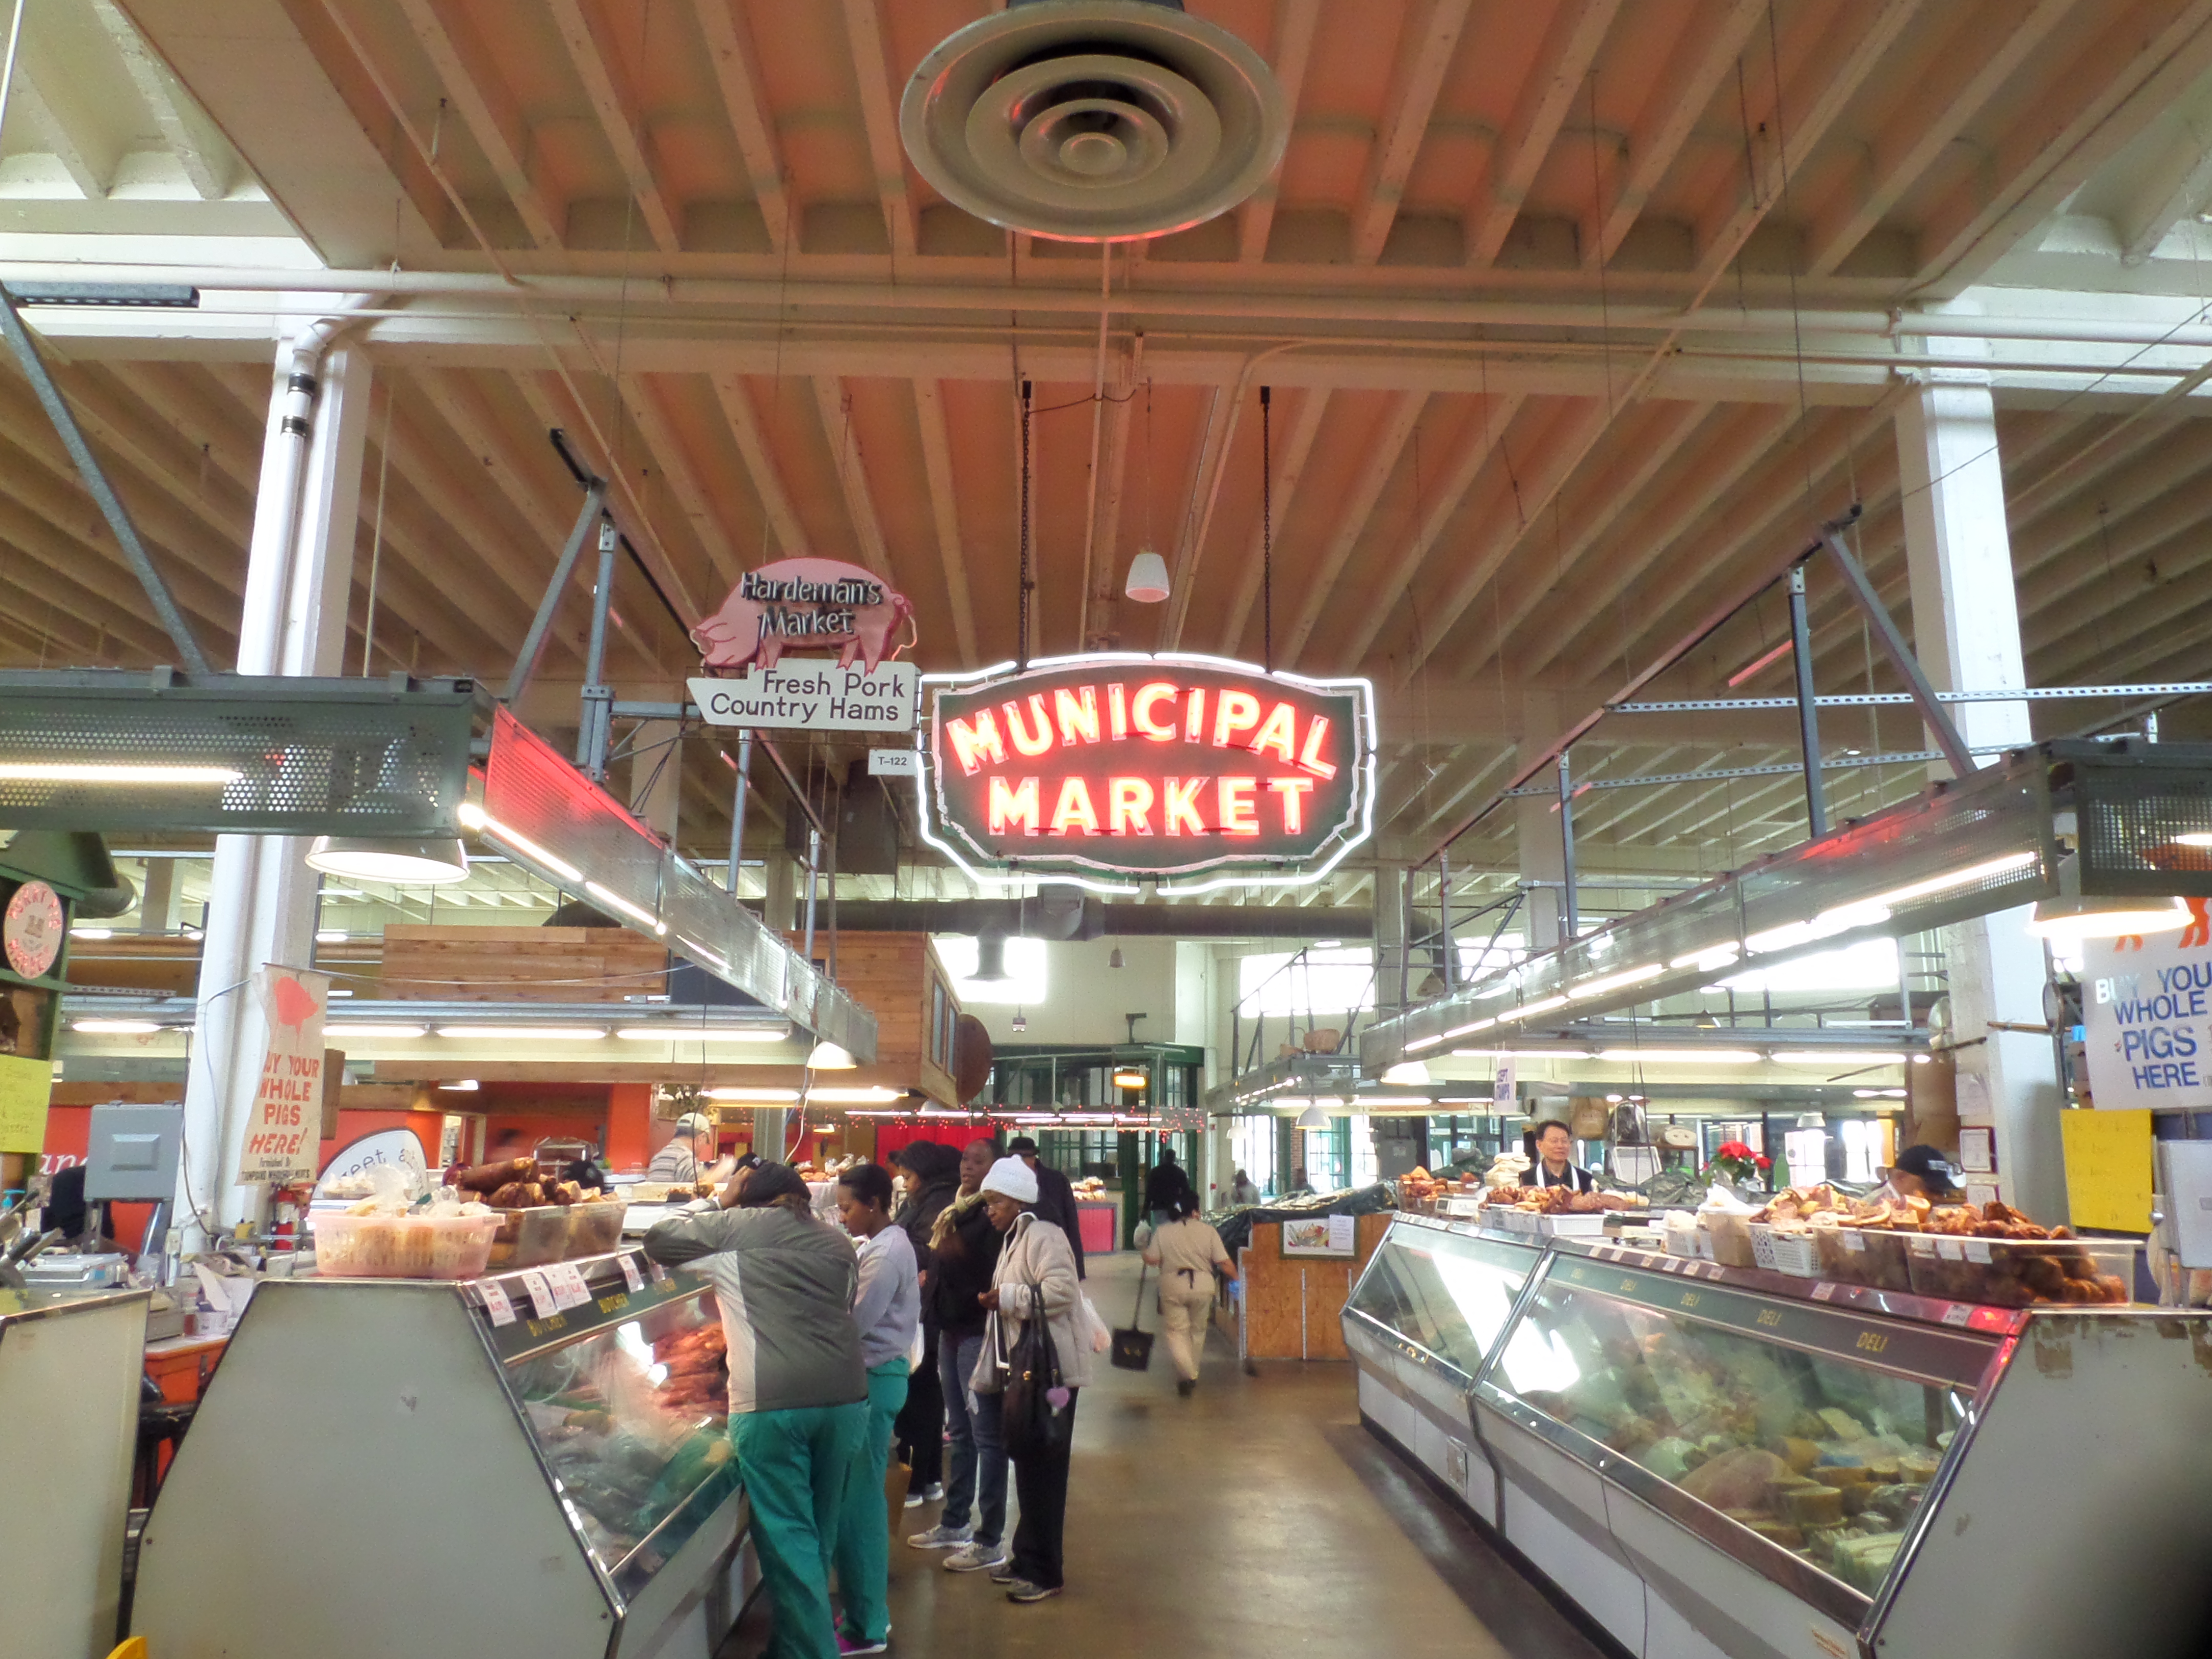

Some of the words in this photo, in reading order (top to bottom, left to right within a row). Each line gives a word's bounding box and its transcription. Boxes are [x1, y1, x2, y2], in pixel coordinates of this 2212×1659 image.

[740, 571, 884, 605] Hardeman's
[758, 606, 856, 639] Market
[763, 670, 831, 696] Fresh
[844, 672, 905, 698] Pork
[711, 693, 818, 724] Country
[830, 697, 899, 720] Hams
[945, 682, 1336, 780] MUNICIPAL
[878, 756, 907, 765] T-122
[988, 776, 1314, 837] MARKET
[2114, 990, 2208, 1025] WHOLE
[2123, 1026, 2197, 1061] PIGS
[289, 1055, 320, 1078] YOUR
[2133, 1061, 2200, 1090] HERE
[264, 1103, 301, 1126] PIGS
[249, 1127, 308, 1155] HERE!
[1756, 1309, 1782, 1327] DELI
[1856, 1331, 1889, 1353] DELI
